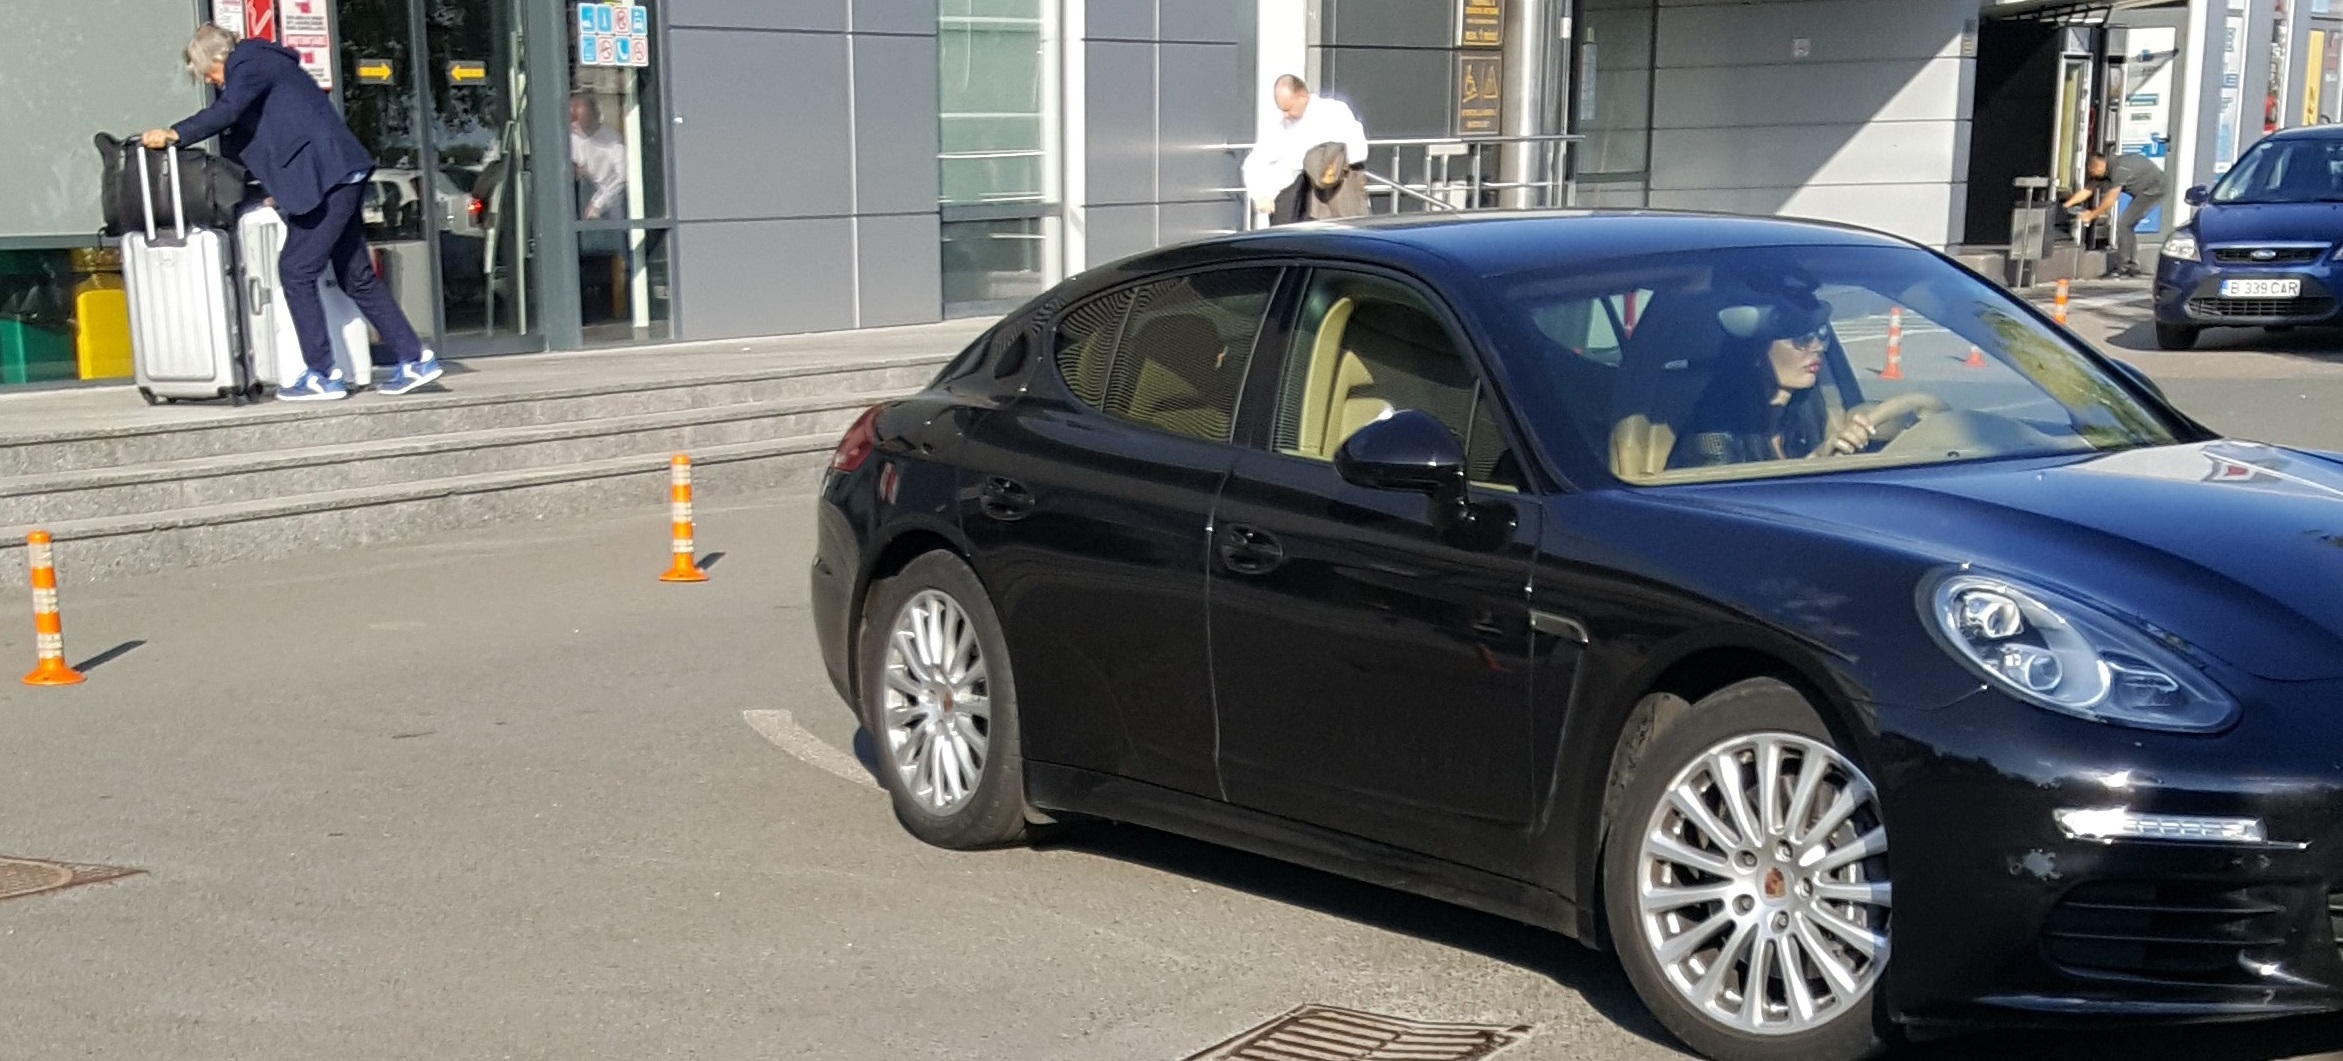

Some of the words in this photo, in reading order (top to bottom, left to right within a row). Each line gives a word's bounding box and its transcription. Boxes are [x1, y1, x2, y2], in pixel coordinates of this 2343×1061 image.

[2230, 281, 2240, 295] B
[2244, 281, 2268, 295] 339
[2270, 281, 2298, 295] CAR
